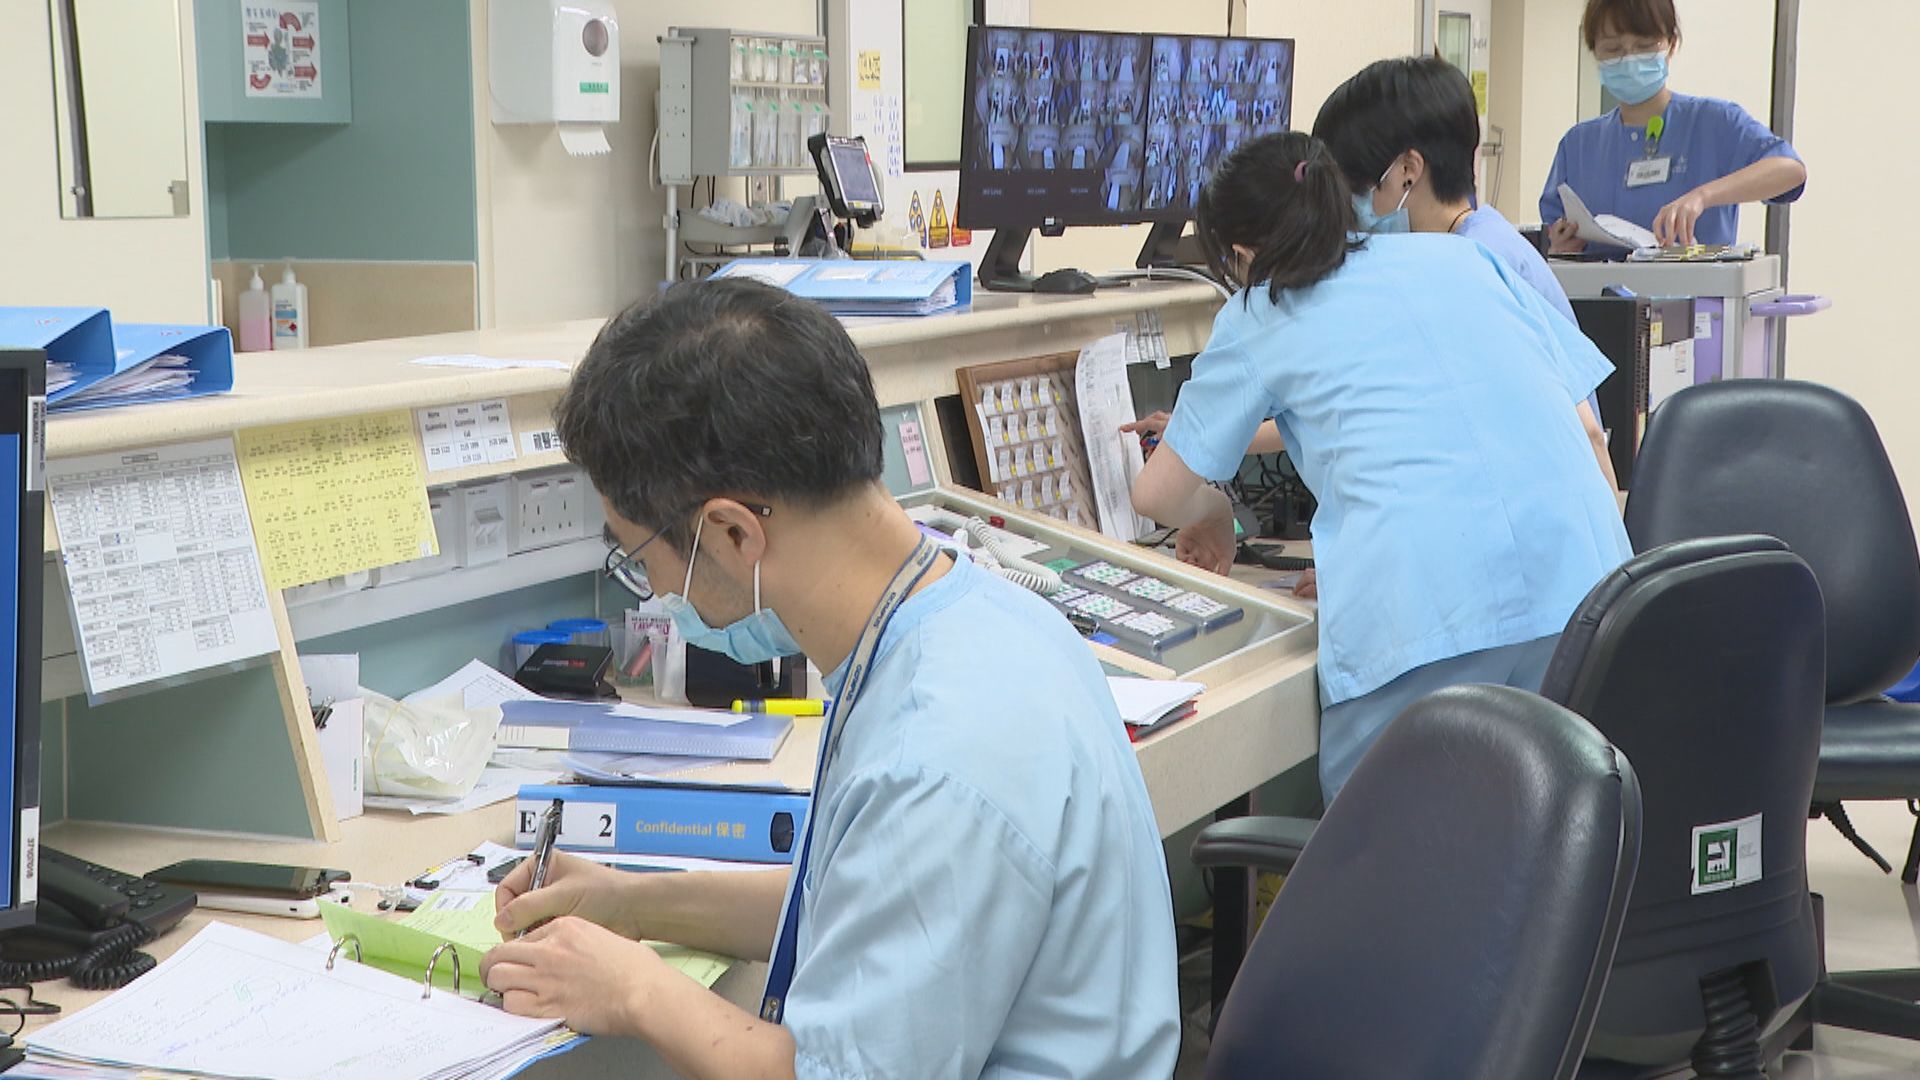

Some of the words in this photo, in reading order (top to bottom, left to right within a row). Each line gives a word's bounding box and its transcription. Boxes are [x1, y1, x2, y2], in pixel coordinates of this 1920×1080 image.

[598, 814, 612, 837] 2
[635, 819, 712, 837] Confidential
[716, 821, 746, 839] 保密
